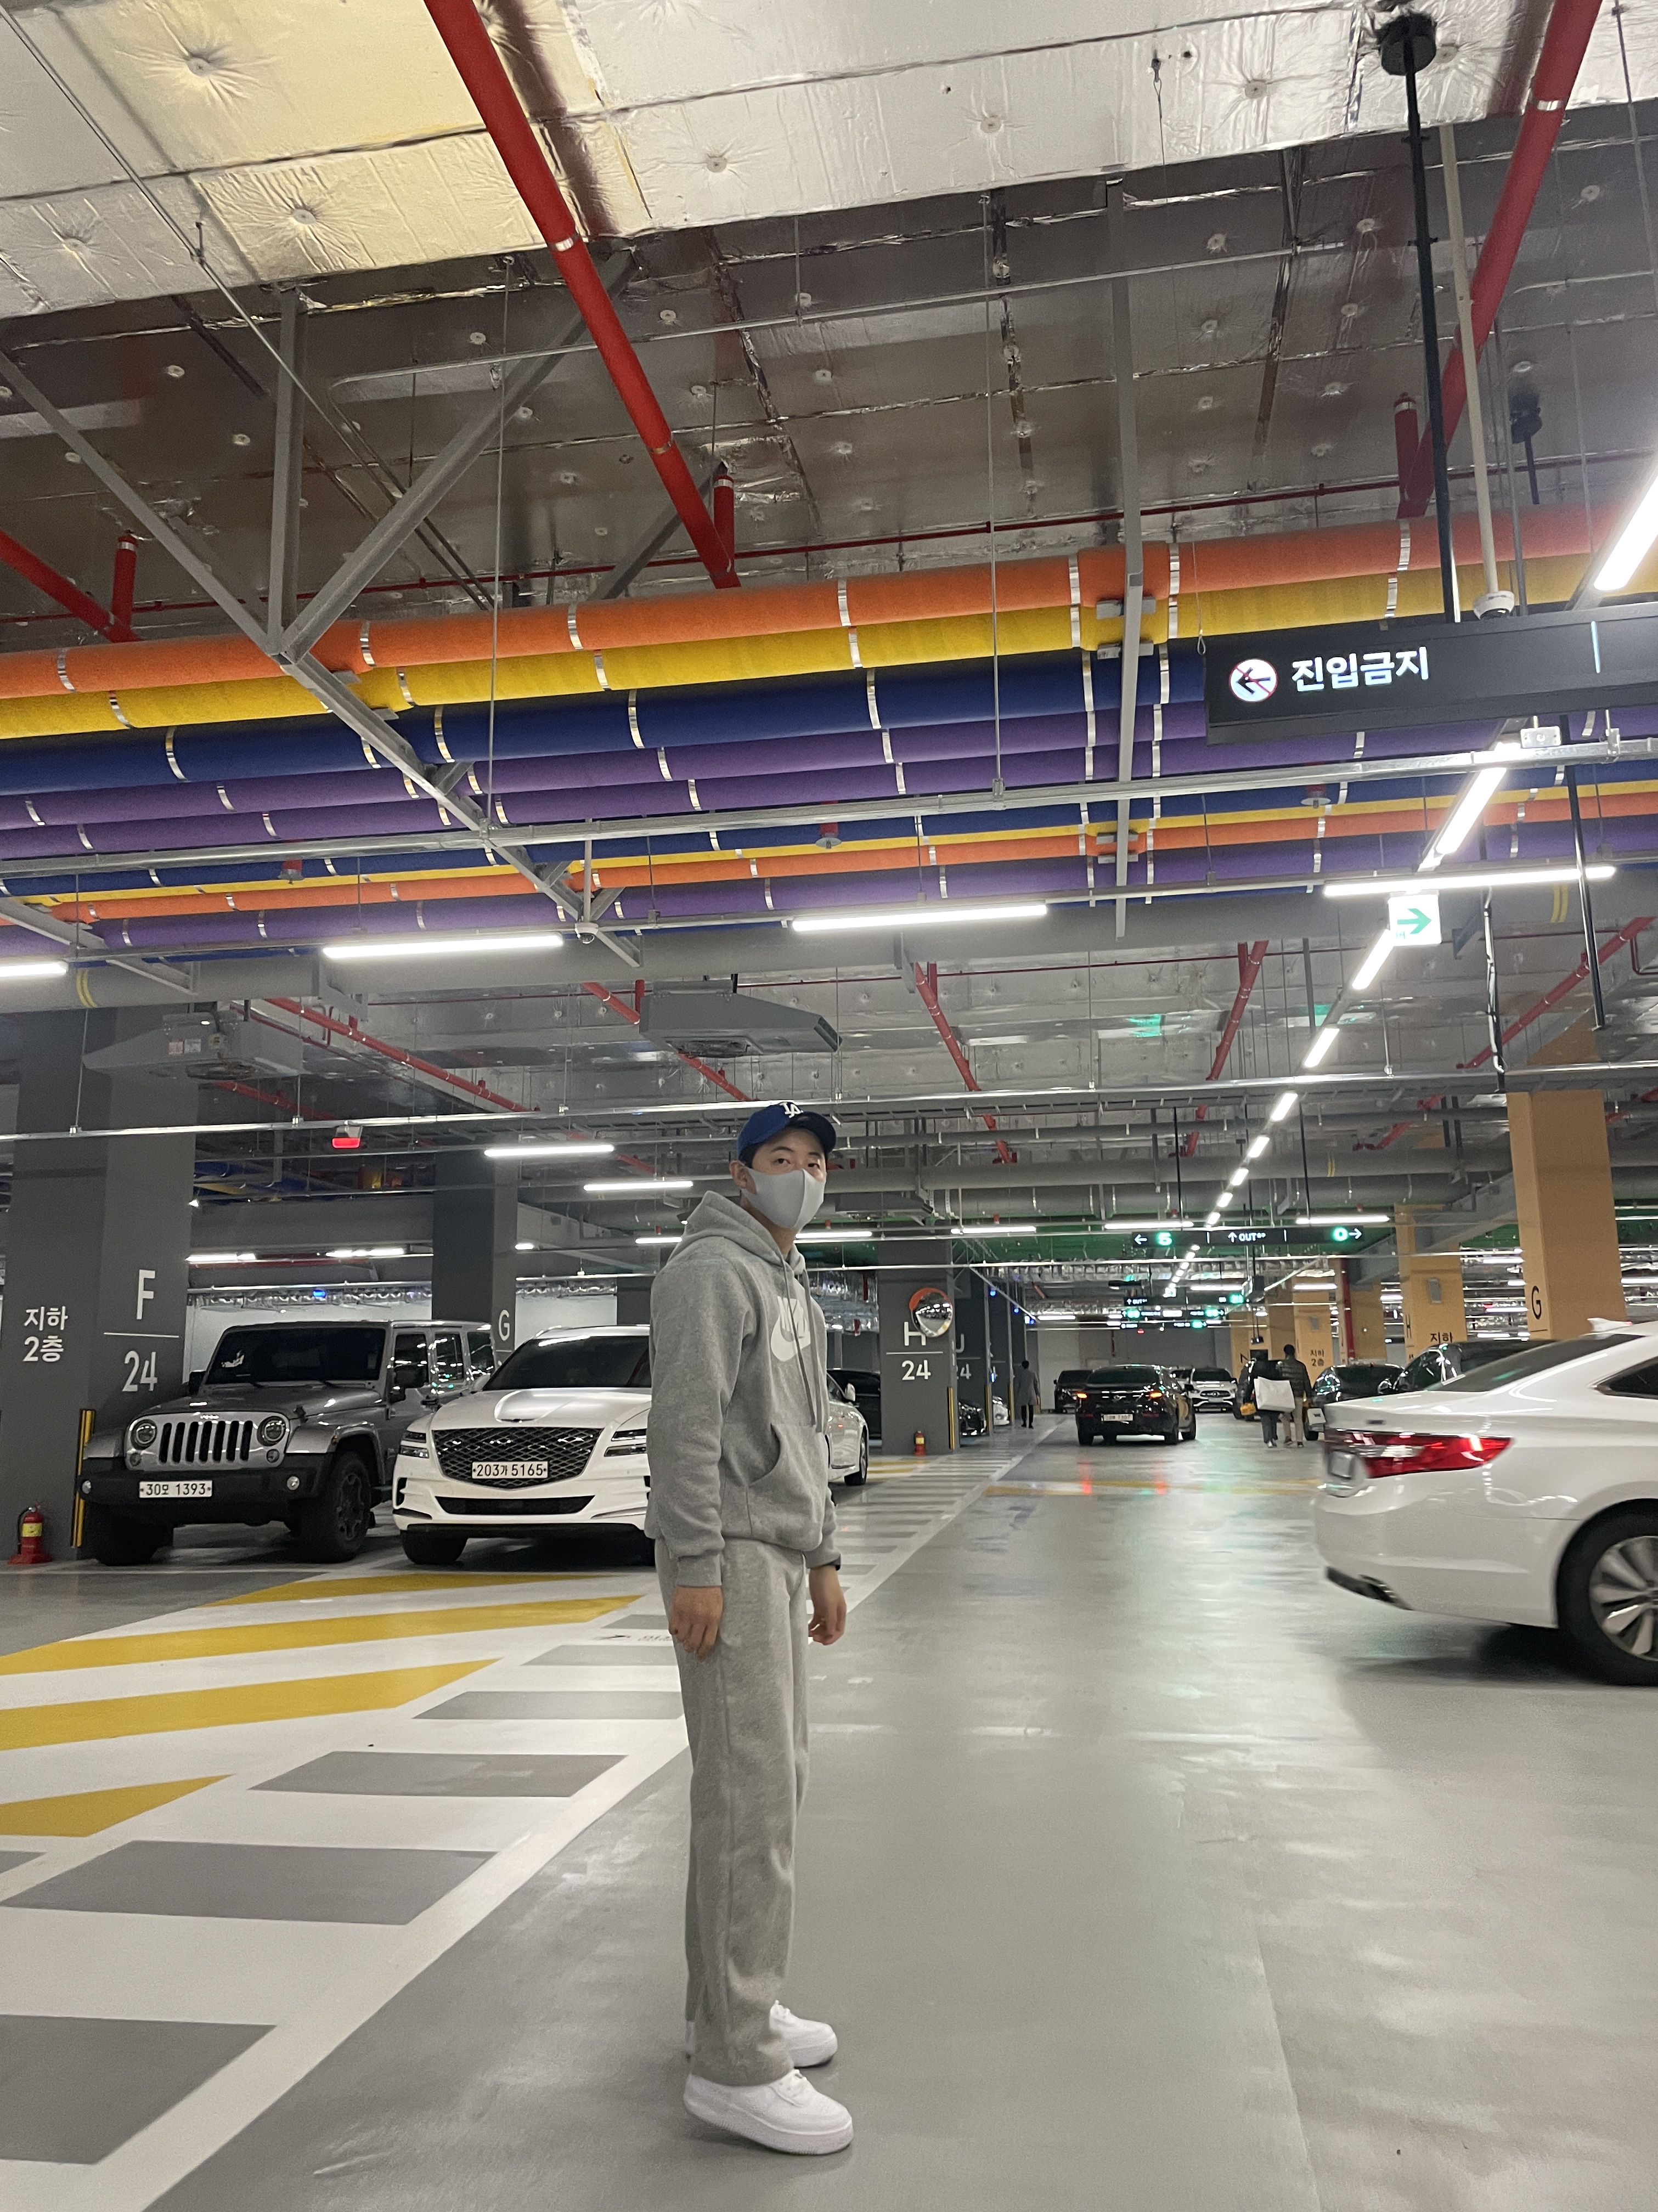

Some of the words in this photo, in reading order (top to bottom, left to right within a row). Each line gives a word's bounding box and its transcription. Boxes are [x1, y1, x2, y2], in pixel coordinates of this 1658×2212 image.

[1292, 646, 1428, 692] 진입금지
[780, 1102, 804, 1118] LA
[1238, 1232, 1257, 1242] OUT
[137, 1269, 155, 1320] F
[1531, 1285, 1542, 1320] G
[24, 1306, 68, 1331] 지하
[499, 1310, 510, 1341] G
[904, 1322, 926, 1346] H
[1430, 1332, 1453, 1343] 지하
[22, 1335, 64, 1362] 2층
[122, 1351, 157, 1392] 24
[901, 1360, 931, 1380] 24
[477, 1464, 507, 1476] 203가
[511, 1464, 543, 1476] 5165
[146, 1483, 169, 1496] 30모
[175, 1483, 206, 1495] 1393
